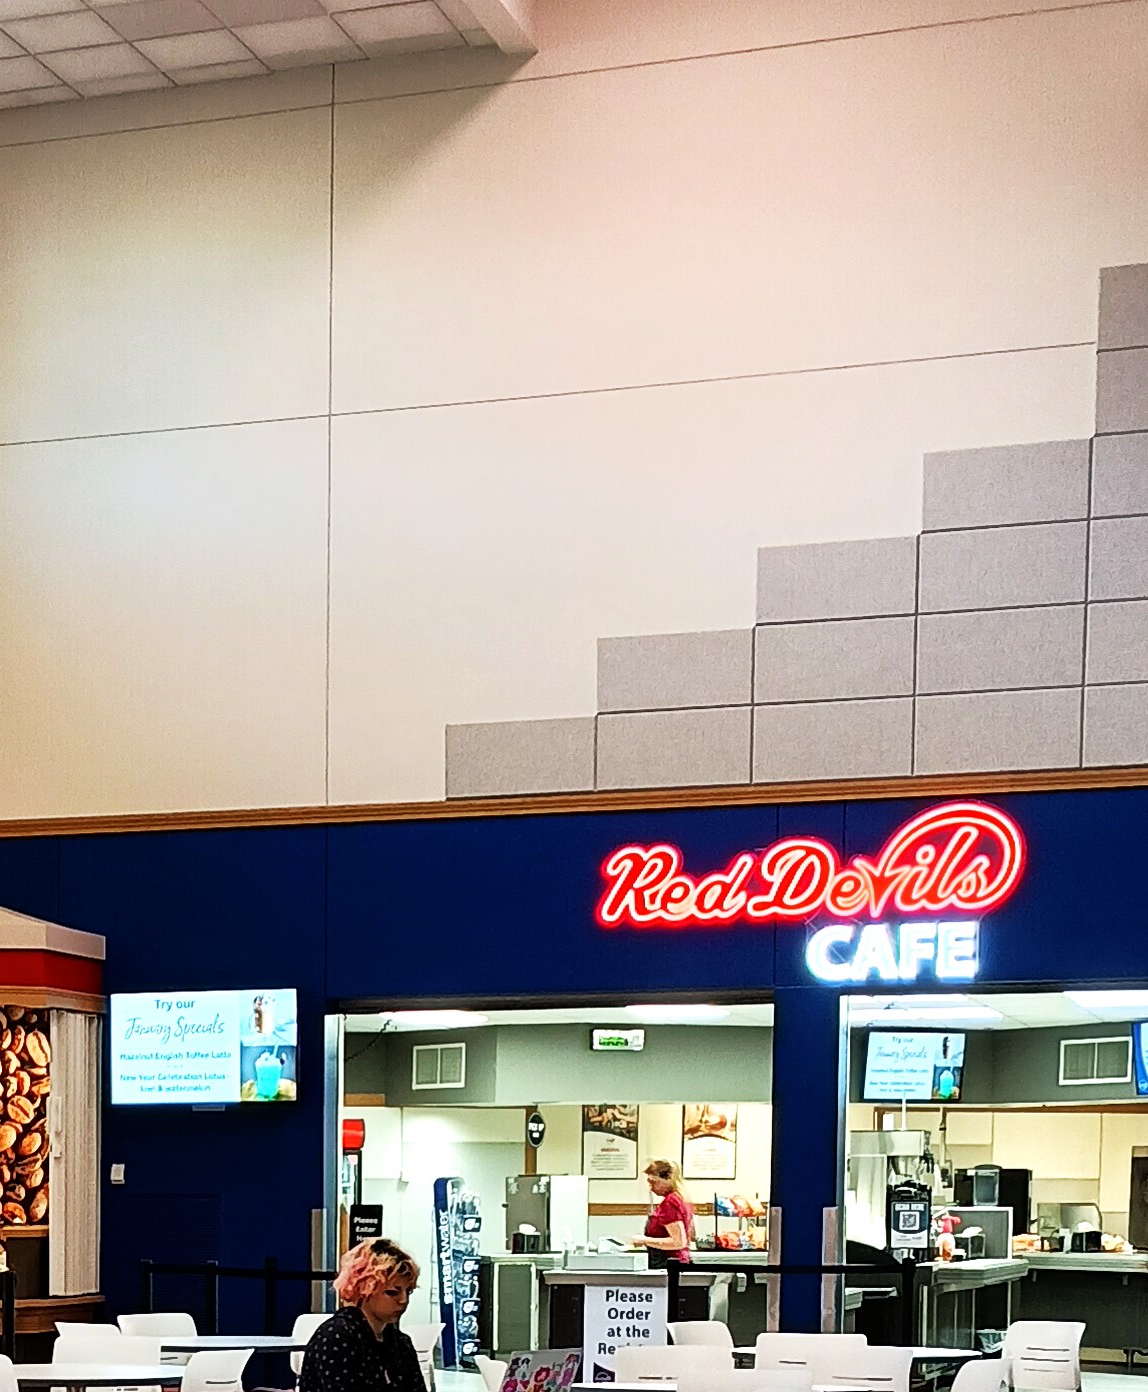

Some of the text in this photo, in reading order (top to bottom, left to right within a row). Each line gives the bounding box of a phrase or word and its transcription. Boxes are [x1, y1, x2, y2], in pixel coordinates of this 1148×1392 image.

[599, 801, 1025, 924] Red Devils
[805, 920, 980, 982] CAFE
[154, 999, 197, 1012] Try our
[173, 1012, 225, 1042] Specials
[438, 1209, 452, 1305] smartwater
[605, 1289, 653, 1303] Please
[607, 1307, 651, 1320] Order
[606, 1325, 650, 1338] at the
